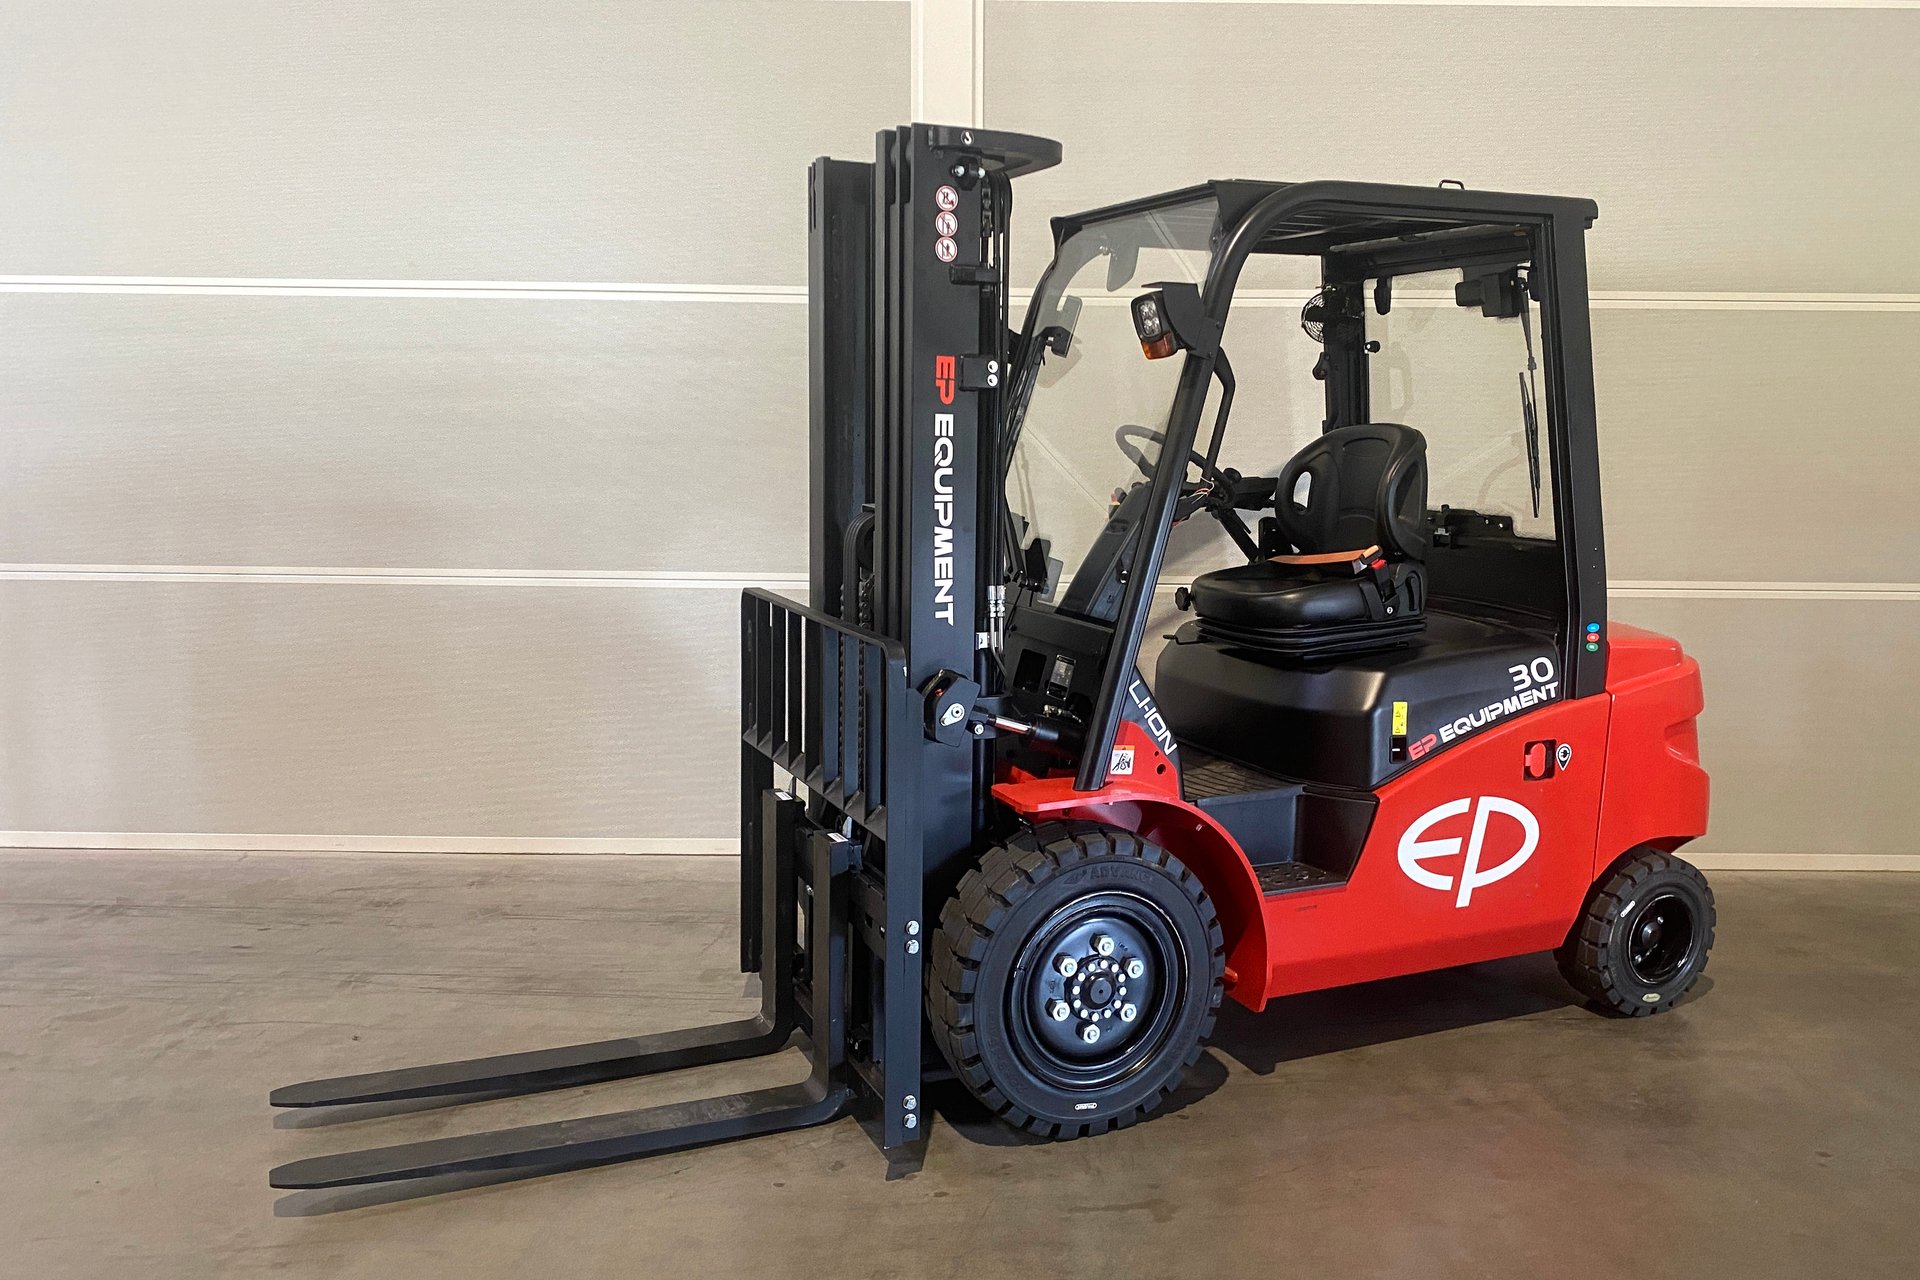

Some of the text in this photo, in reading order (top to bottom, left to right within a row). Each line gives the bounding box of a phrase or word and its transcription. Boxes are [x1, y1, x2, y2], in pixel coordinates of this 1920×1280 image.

[934, 355, 956, 626] EP EQUIPMENT
[1408, 734, 1437, 761] EP
[1438, 681, 1559, 743] EQUIPMENT
[1508, 657, 1554, 692] 30
[1397, 796, 1540, 908] EP
